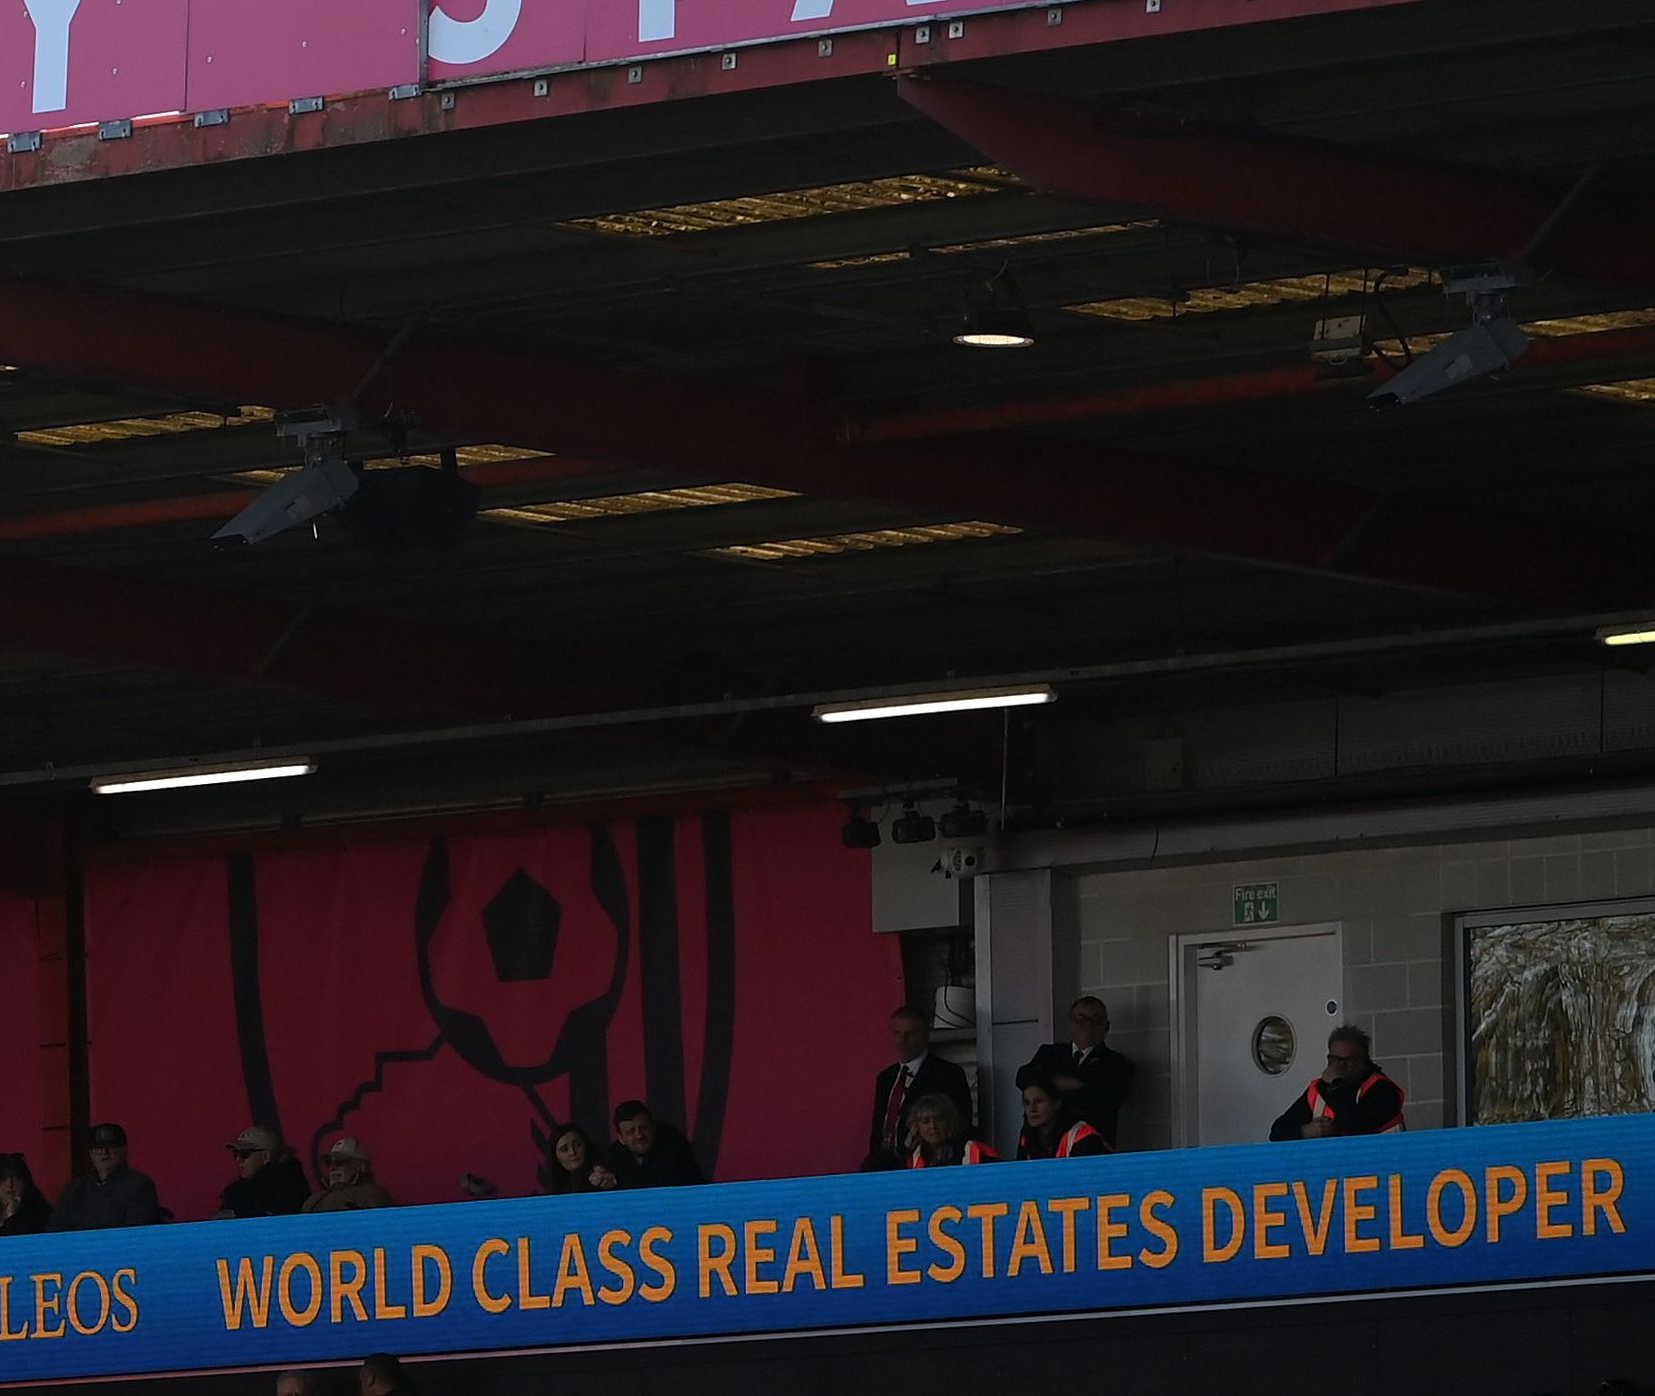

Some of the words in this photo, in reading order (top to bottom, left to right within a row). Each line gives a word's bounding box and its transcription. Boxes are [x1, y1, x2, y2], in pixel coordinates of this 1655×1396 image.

[1235, 887, 1255, 902] Fire
[1257, 886, 1276, 901] exit
[217, 1243, 452, 1330] WORLD
[472, 1226, 676, 1314] CLASS
[698, 1216, 865, 1299] REAL
[887, 1190, 1178, 1285] ESTATES
[1201, 1157, 1627, 1264] DEVELOPER
